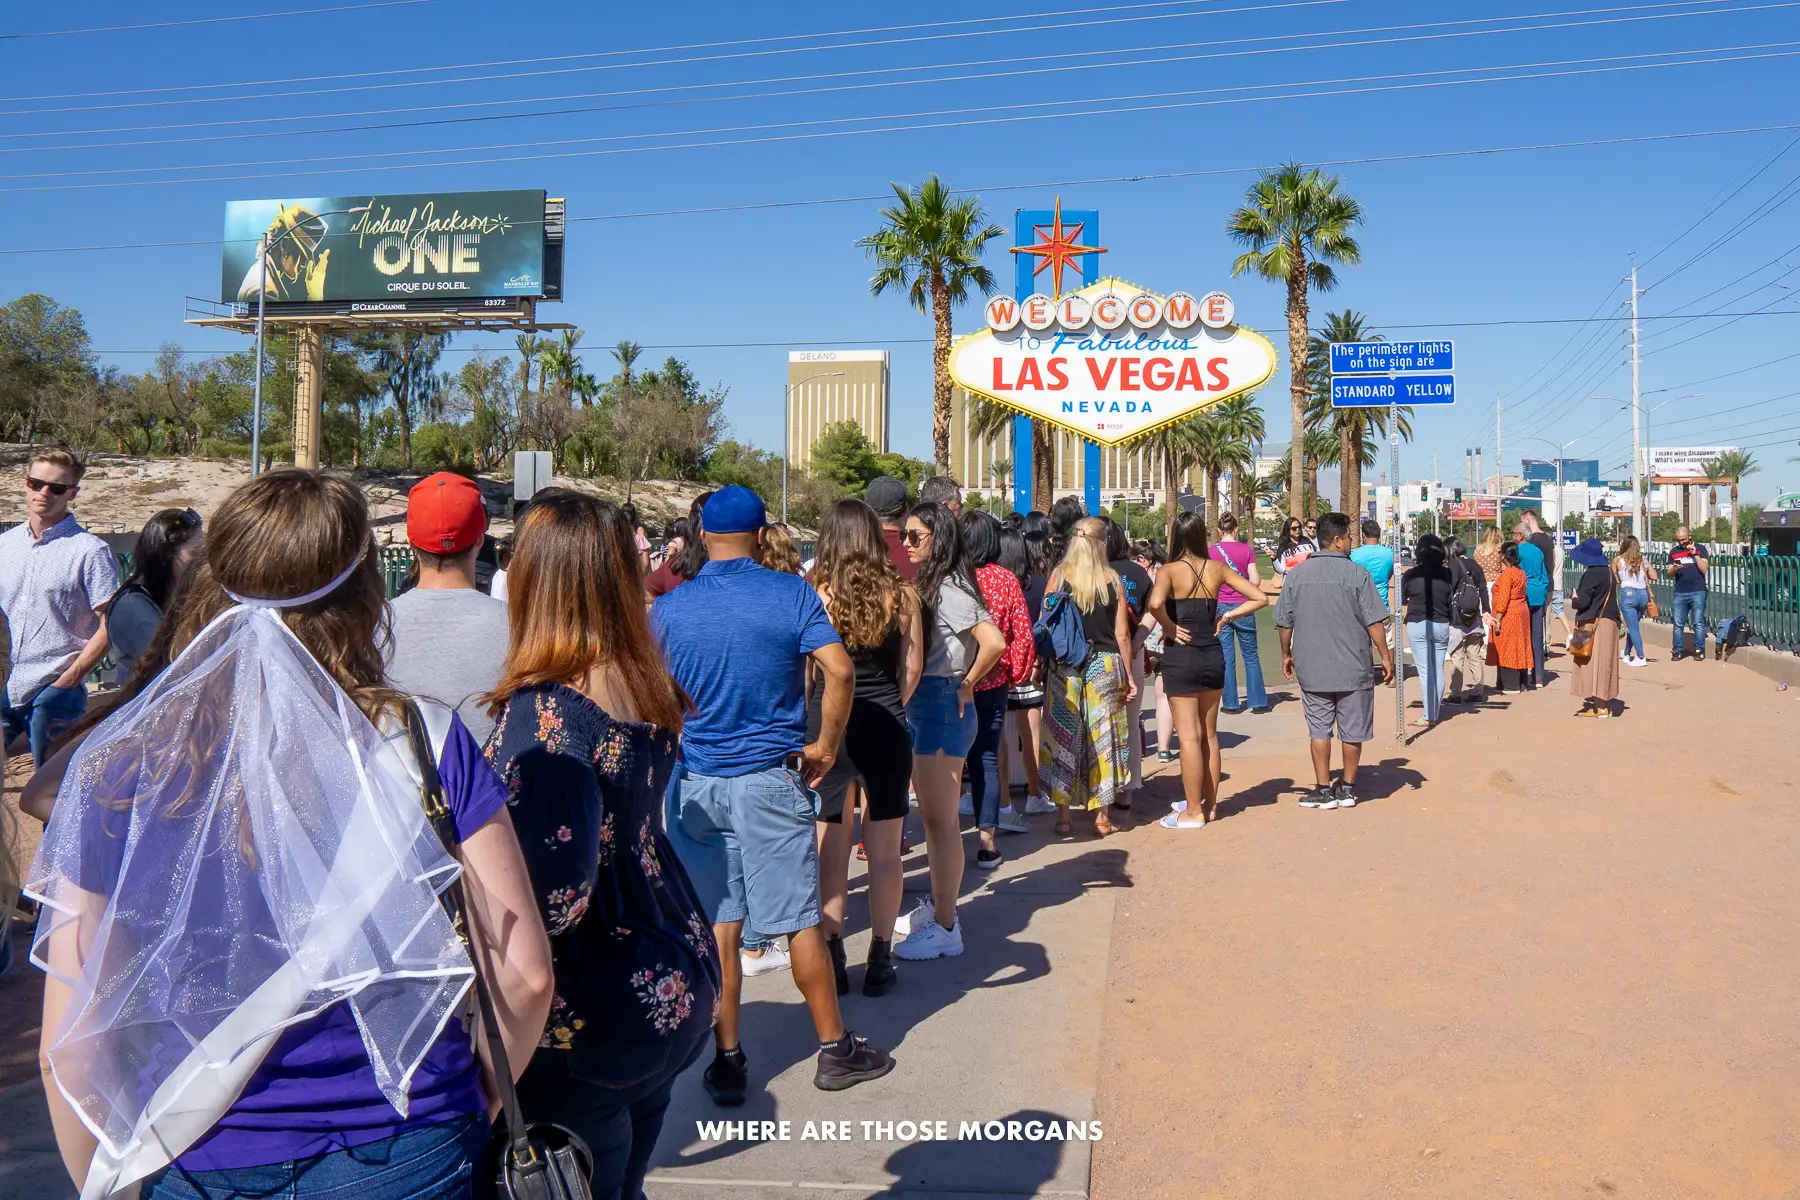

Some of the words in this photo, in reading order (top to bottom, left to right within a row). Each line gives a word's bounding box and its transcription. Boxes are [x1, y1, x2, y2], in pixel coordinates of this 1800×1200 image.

[350, 197, 417, 249] Michael
[410, 201, 498, 251] Jackson
[373, 234, 480, 276] ONE
[387, 282, 420, 293] CIRQUE
[422, 282, 435, 290] DU
[437, 281, 470, 290] SOLEIL.
[990, 299, 1225, 324] WELCOME
[1016, 336, 1041, 351] TO
[1051, 332, 1198, 355] Fabulous
[1334, 344, 1354, 356] The
[1358, 343, 1414, 358] perimeter
[1418, 342, 1450, 357] lights
[799, 352, 837, 361] DELANO
[1350, 359, 1363, 369] on
[1368, 357, 1386, 368] the
[1389, 355, 1413, 370] sign
[1417, 356, 1435, 367] are
[992, 356, 1069, 391] LAS
[1084, 356, 1229, 391] VEGAS
[1334, 385, 1395, 398] STANDARD
[1406, 383, 1453, 397] YELLOW
[1061, 401, 1153, 413] NEVADA
[1447, 502, 1465, 510] TAO
